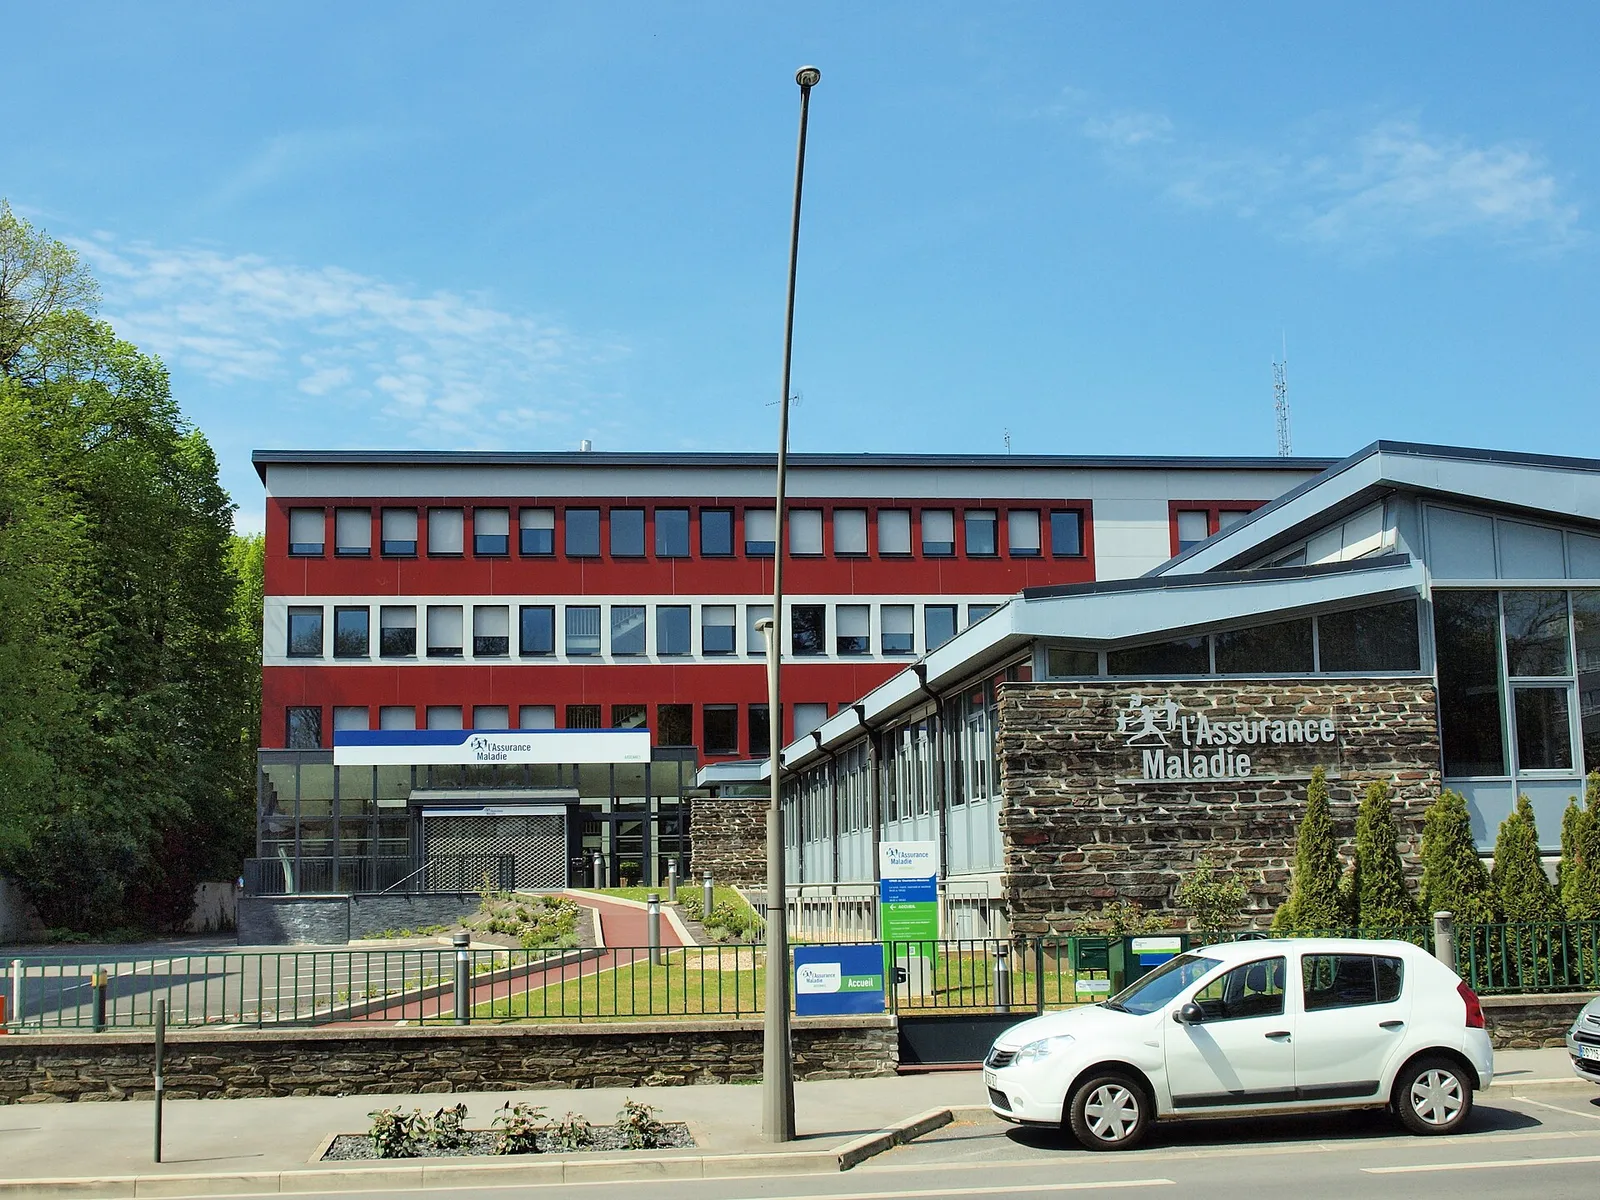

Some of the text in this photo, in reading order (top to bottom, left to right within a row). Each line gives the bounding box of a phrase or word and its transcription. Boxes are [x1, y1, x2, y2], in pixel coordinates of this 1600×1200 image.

[1181, 715, 1335, 745] l'Assurance
[488, 743, 531, 751] l'Assurance
[477, 752, 507, 760] Maladie
[1142, 748, 1251, 779] Maladie
[848, 978, 874, 987] Accueil
